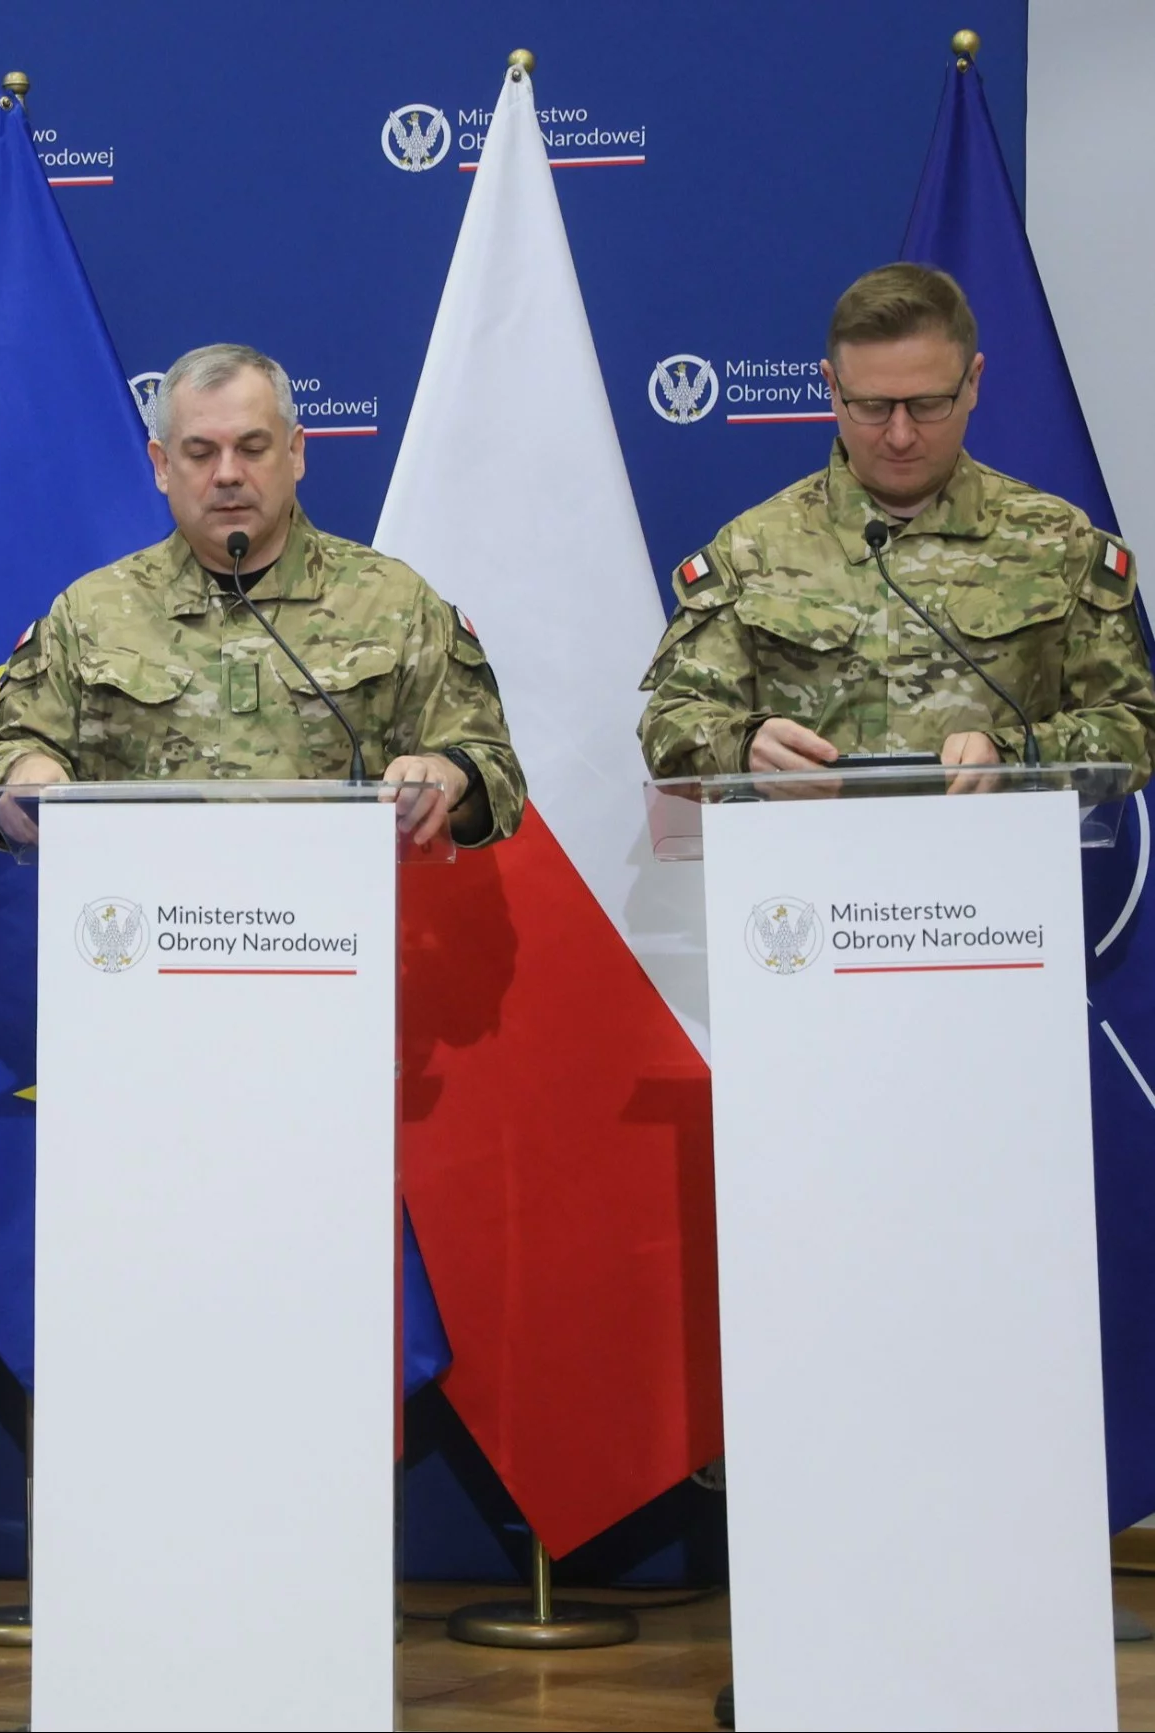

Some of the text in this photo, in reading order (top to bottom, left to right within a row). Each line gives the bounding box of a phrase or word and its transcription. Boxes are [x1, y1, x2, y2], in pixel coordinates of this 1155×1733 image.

[37, 146, 114, 168] odowej
[726, 359, 822, 378] Ministers
[726, 383, 802, 404] Obrony
[157, 905, 295, 925] Ministerstwo
[830, 902, 977, 922] Ministerstwo
[157, 931, 358, 957] Obrony Narodowej
[832, 924, 1044, 952] Obrony Narodowej
